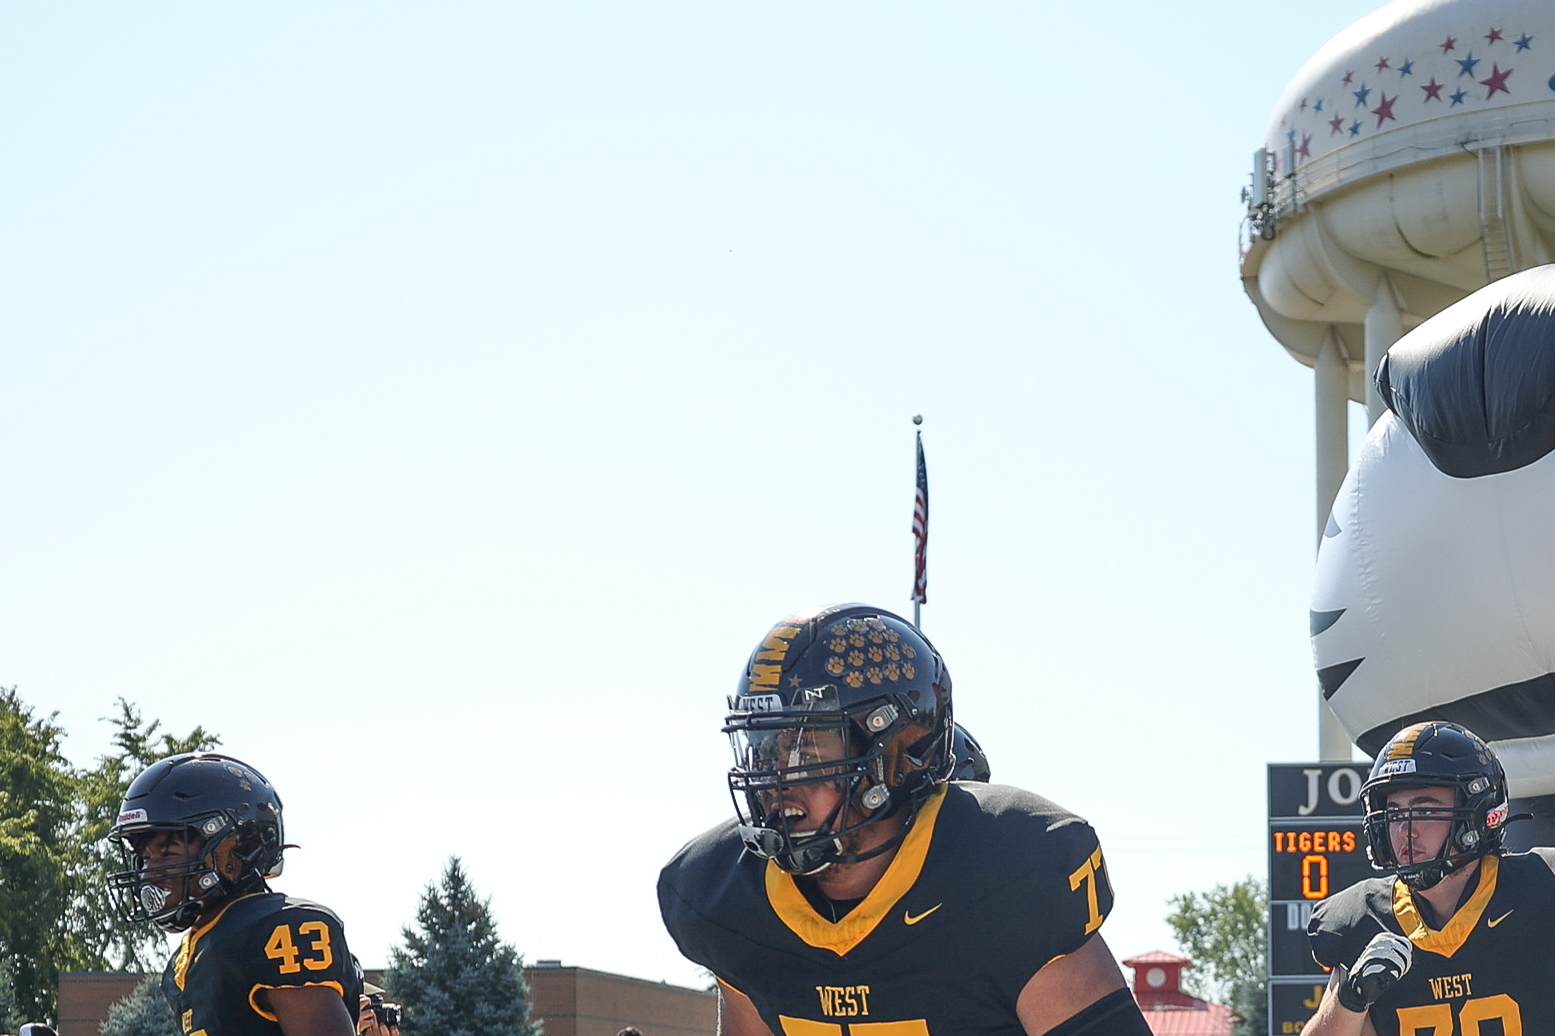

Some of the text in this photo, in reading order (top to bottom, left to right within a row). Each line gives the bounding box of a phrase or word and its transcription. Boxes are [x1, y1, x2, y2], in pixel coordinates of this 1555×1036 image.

[1298, 768, 1370, 816] JO
[1274, 831, 1356, 853] TIGERS
[1302, 854, 1328, 899] 0
[264, 921, 333, 975] 43
[816, 985, 870, 1017] WEST
[1428, 972, 1474, 1000] WEST
